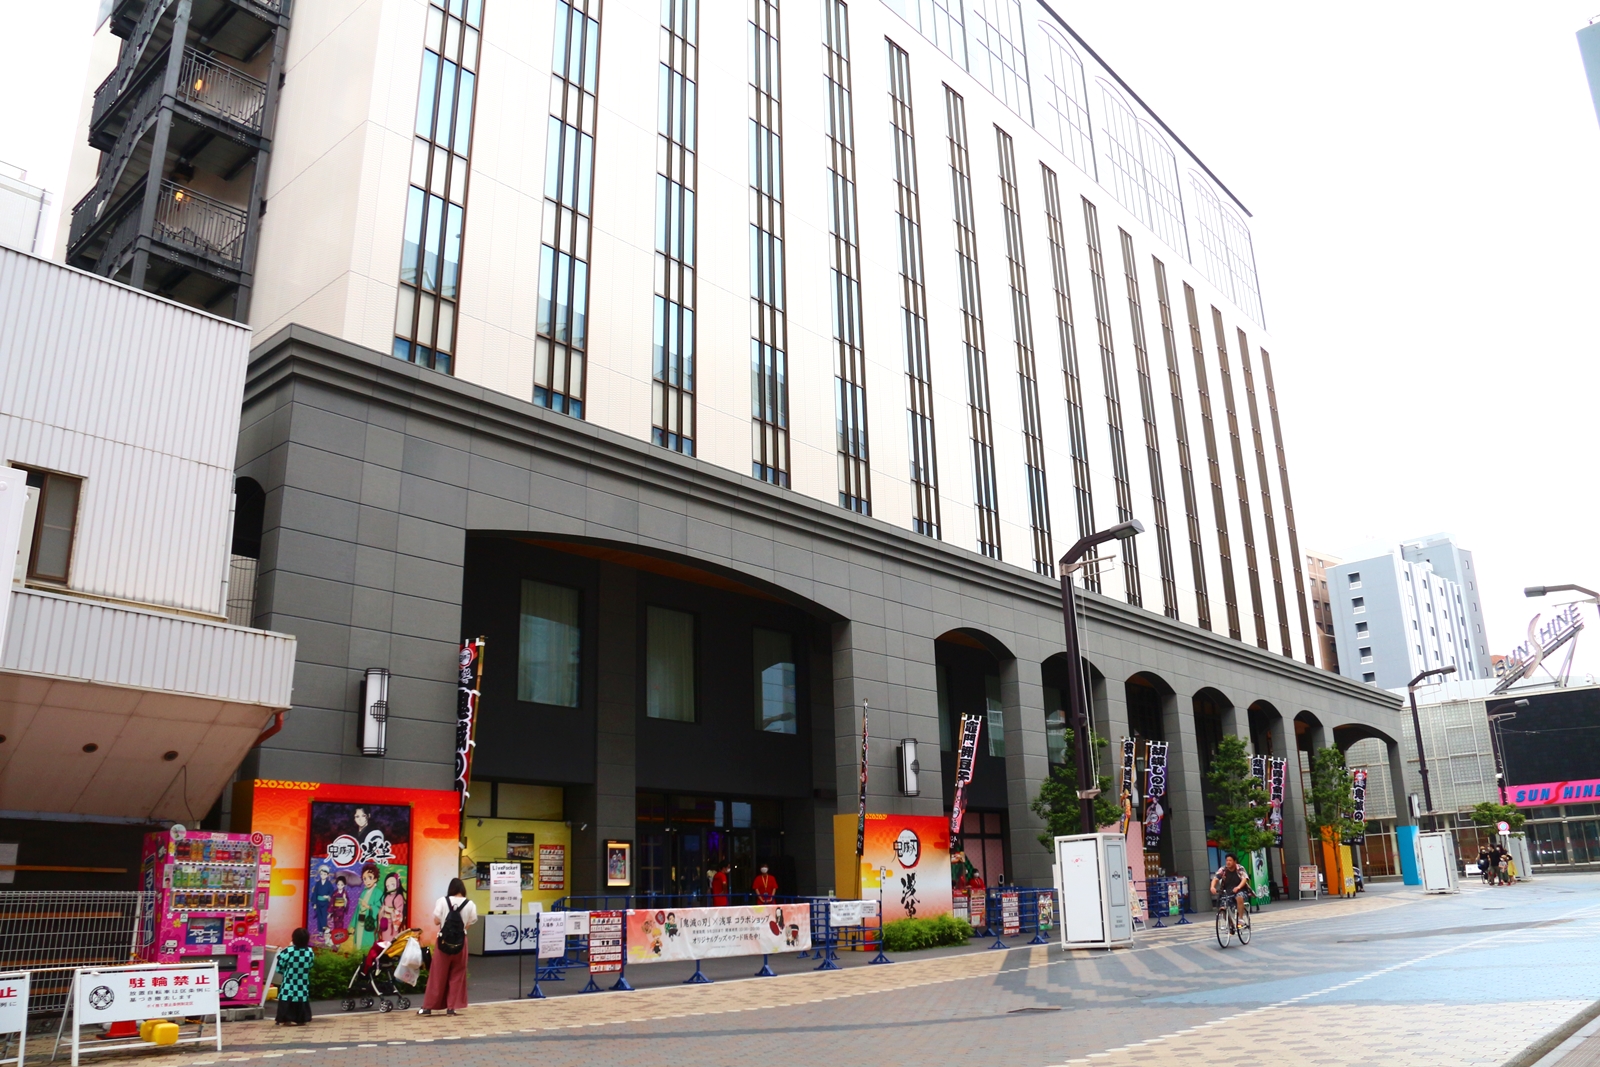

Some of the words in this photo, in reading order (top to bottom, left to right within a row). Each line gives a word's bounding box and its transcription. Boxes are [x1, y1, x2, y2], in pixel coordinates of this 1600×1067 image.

[189, 928, 218, 937] スマート
[195, 936, 218, 944] ボール
[128, 975, 210, 989] 駐輪禁止
